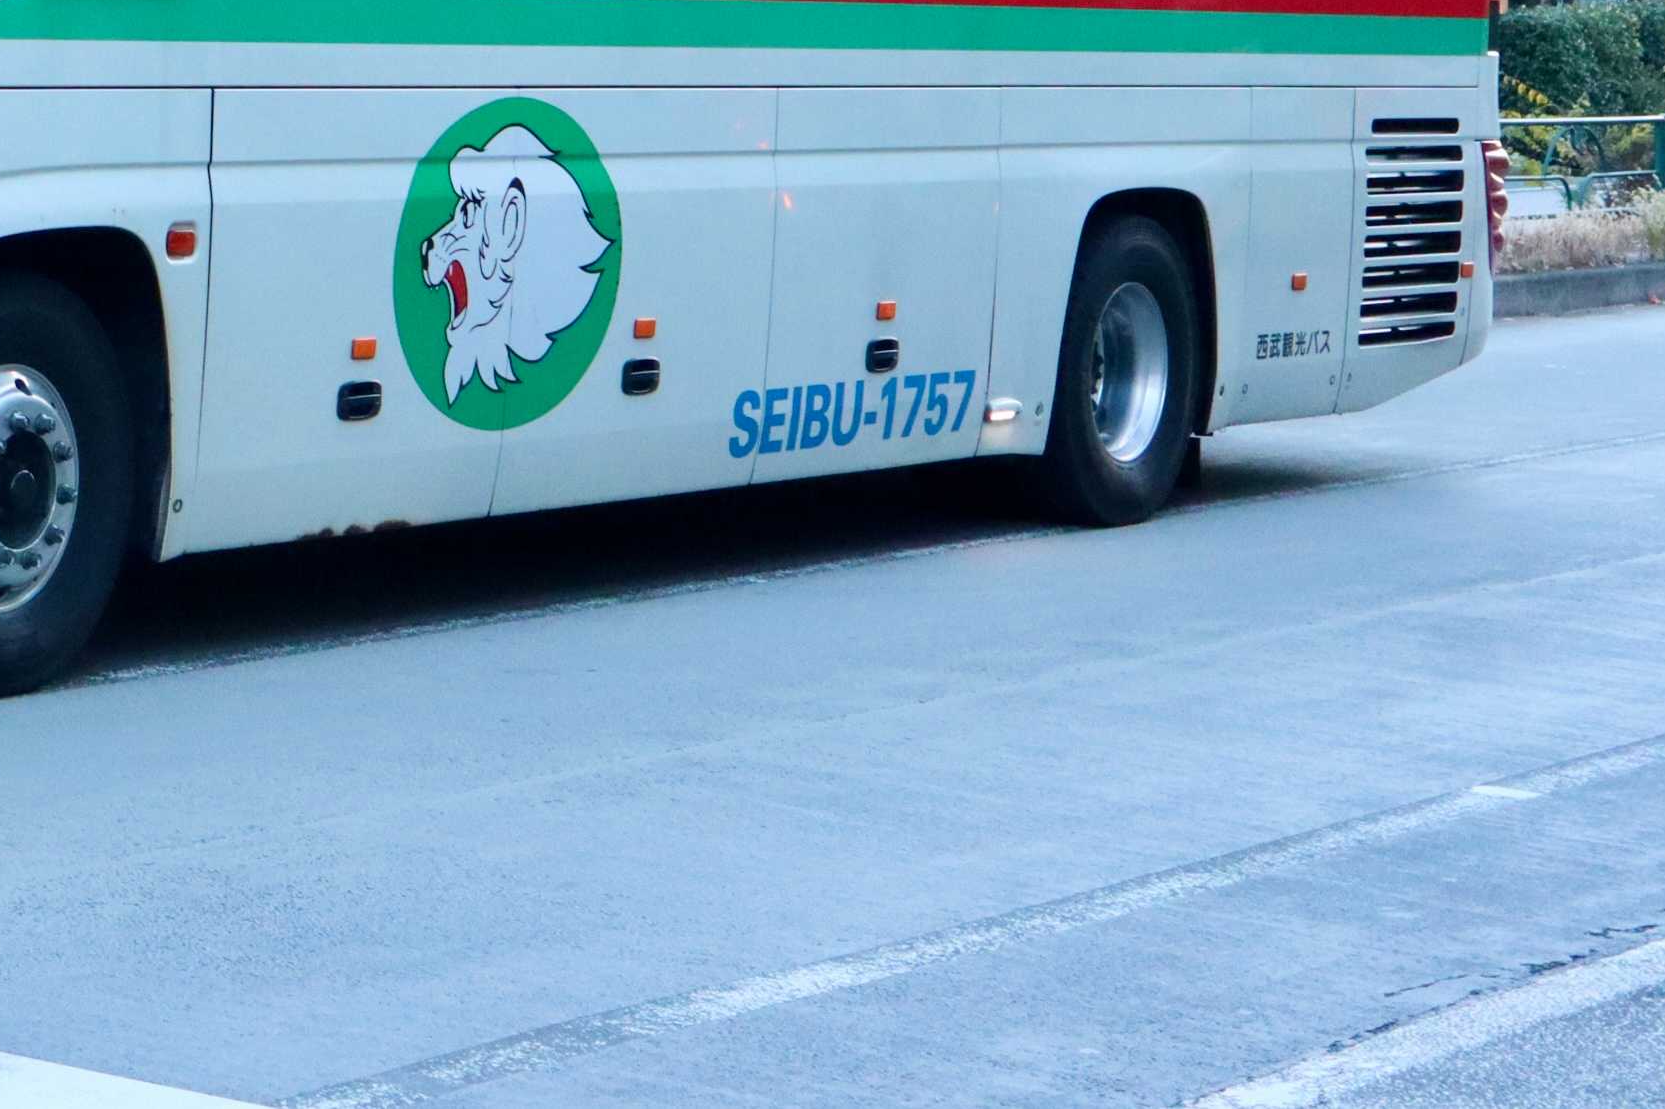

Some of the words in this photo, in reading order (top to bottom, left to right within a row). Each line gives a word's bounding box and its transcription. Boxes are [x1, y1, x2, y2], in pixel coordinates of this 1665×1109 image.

[1256, 330, 1331, 360] 西武観光バス
[728, 369, 976, 459] SEIBU-1757
